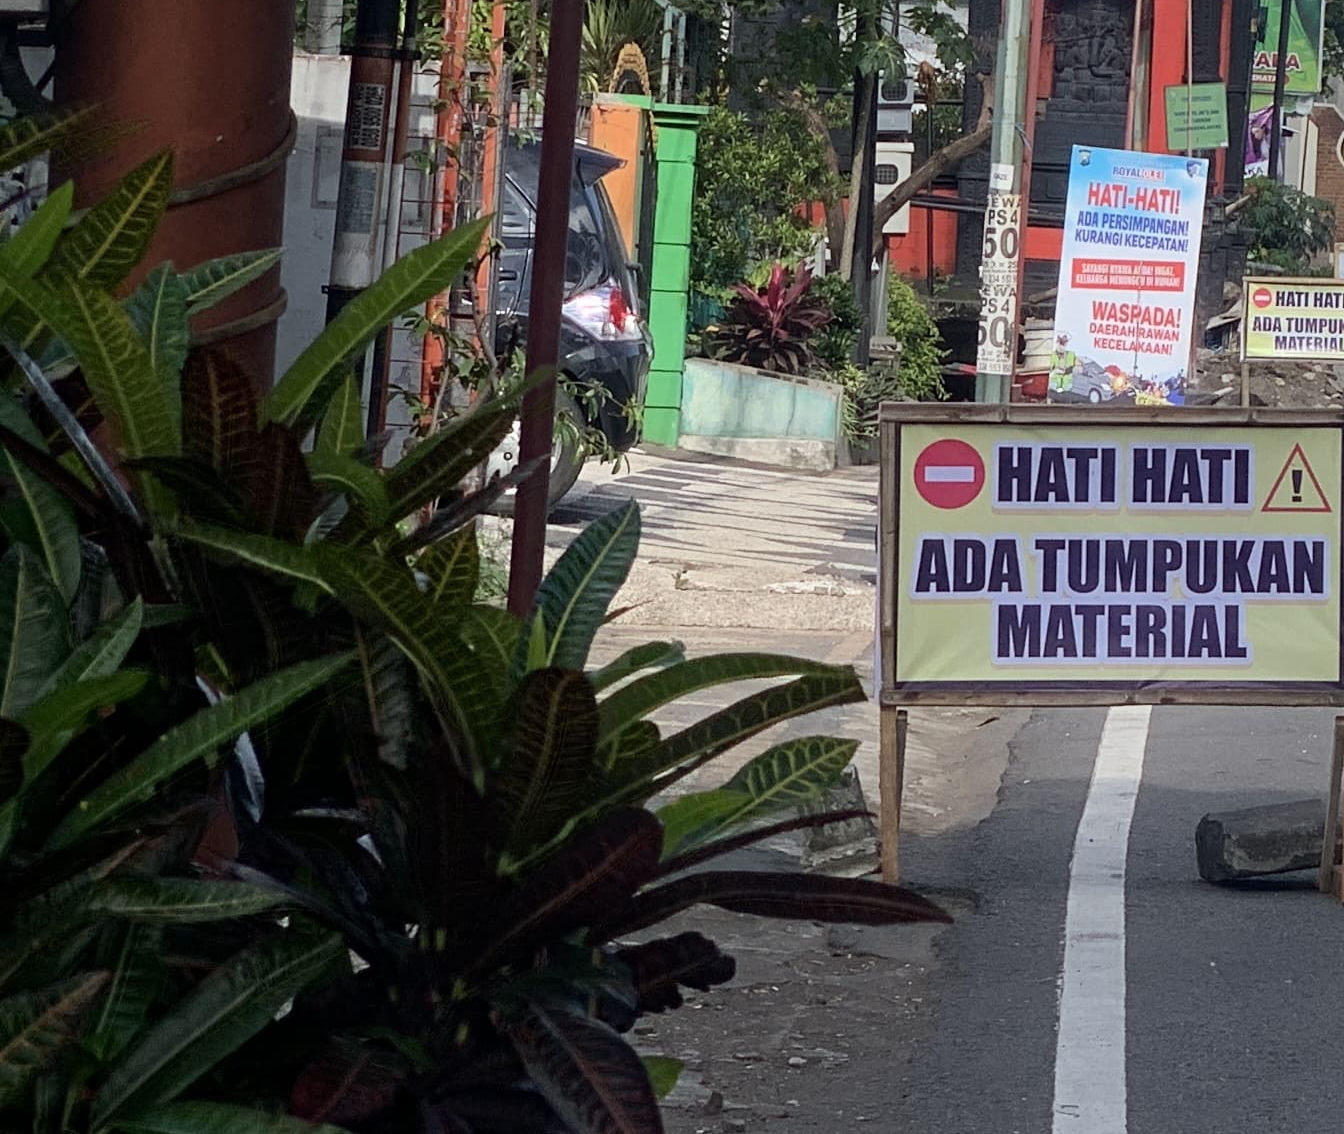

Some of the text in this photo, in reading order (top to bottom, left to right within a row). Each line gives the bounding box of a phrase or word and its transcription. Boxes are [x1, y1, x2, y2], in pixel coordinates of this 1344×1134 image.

[1088, 182, 1181, 215] HATI-HATI!
[988, 209, 1018, 225] PS 4
[1077, 210, 1189, 237] ADA PERSIMPANGAN!
[984, 227, 1019, 259] 50
[1075, 228, 1189, 253] KURANGI KECEPATAN!
[1001, 298, 1010, 315] 4
[1275, 291, 1309, 308] HATI
[1092, 300, 1182, 329] WASPADA!
[1252, 316, 1282, 333] ADA
[1089, 322, 1180, 342] DAERAH RAWAN
[1094, 337, 1173, 355] KECELAKAAN!
[998, 446, 1250, 505] HATI HATI
[915, 538, 1326, 595] ADA TUMPUKAN
[997, 603, 1248, 659] MATERIAL
